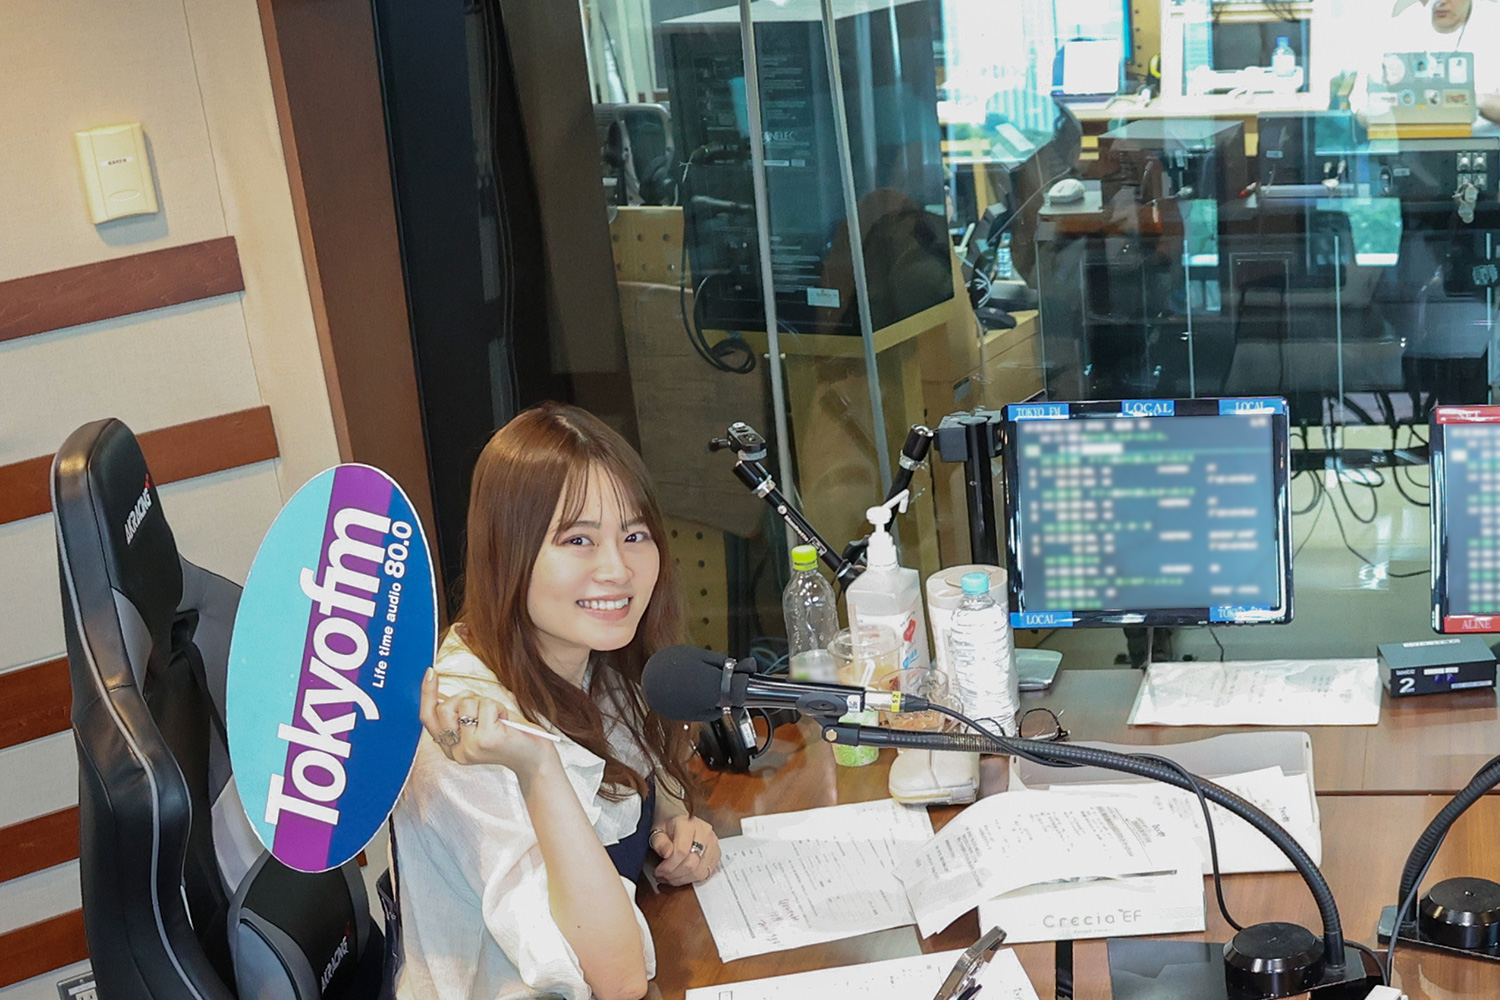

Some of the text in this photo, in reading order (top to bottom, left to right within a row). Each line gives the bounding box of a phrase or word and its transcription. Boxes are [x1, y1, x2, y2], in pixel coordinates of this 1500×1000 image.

[1016, 406, 1061, 417] TOKYO FM
[1124, 401, 1174, 416] LOCAL
[372, 520, 413, 689] Life time audio 80.0
[1026, 613, 1056, 625] LOCAL
[1461, 619, 1491, 630] ALINE
[264, 507, 392, 826] Tokyofm
[1043, 909, 1142, 928] Crecia EF
